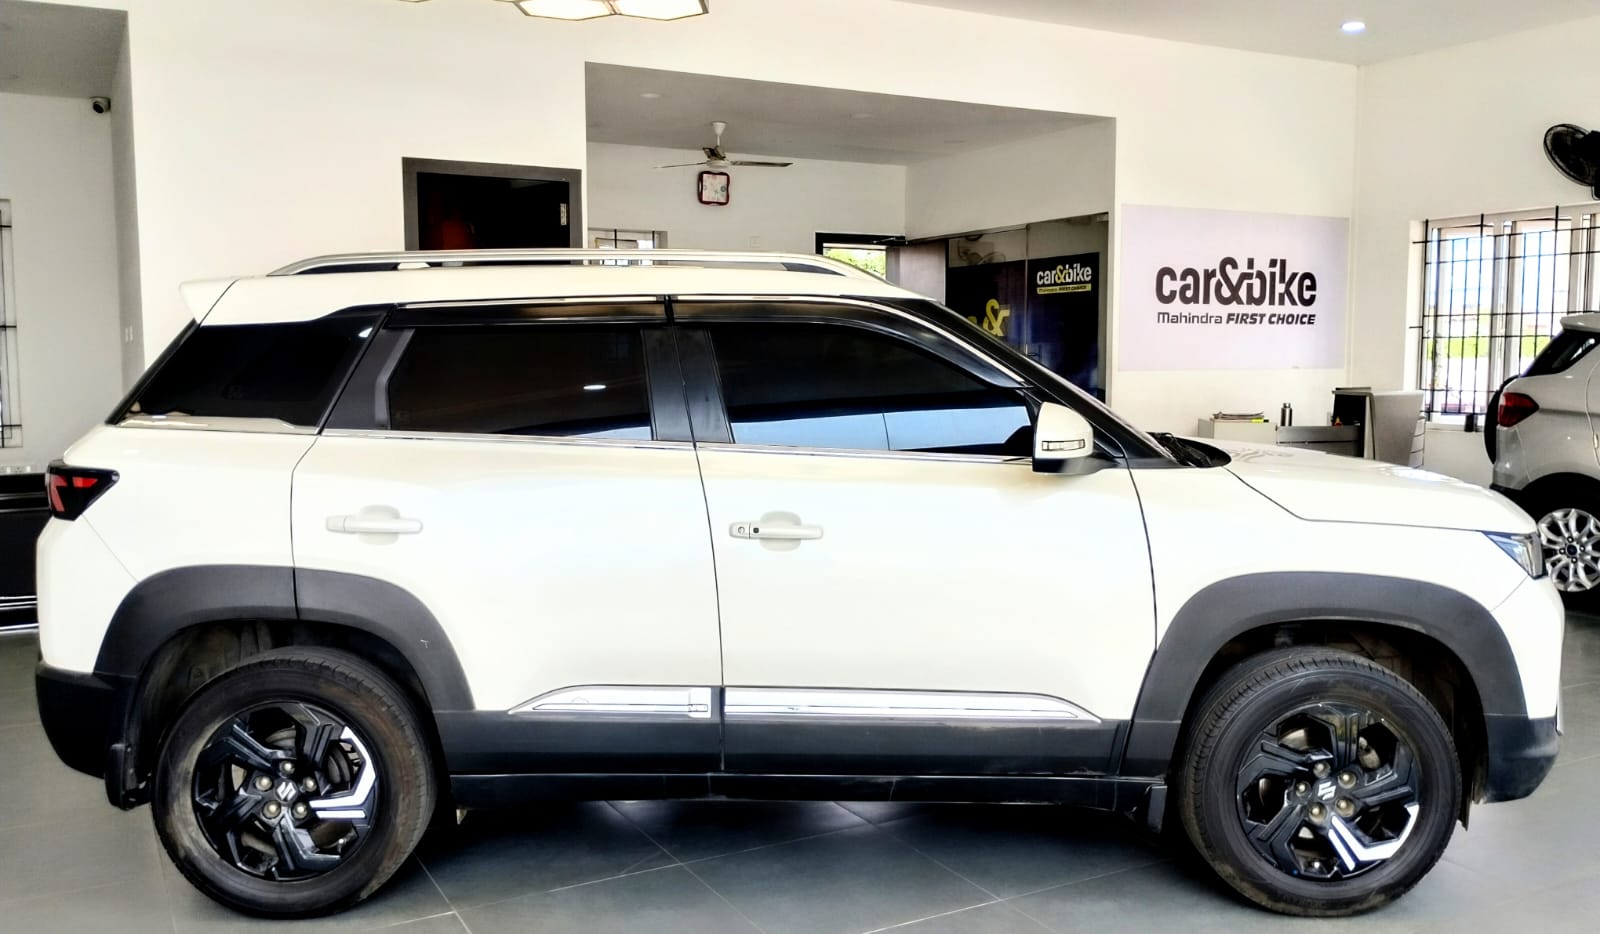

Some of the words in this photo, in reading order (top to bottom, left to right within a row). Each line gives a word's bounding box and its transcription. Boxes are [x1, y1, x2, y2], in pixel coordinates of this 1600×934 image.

[1036, 263, 1092, 285] car&bike
[1155, 256, 1317, 307] car&bike
[1157, 311, 1222, 324] Mahindra
[1226, 312, 1266, 325] FIRST
[1268, 313, 1316, 325] CHOICE
